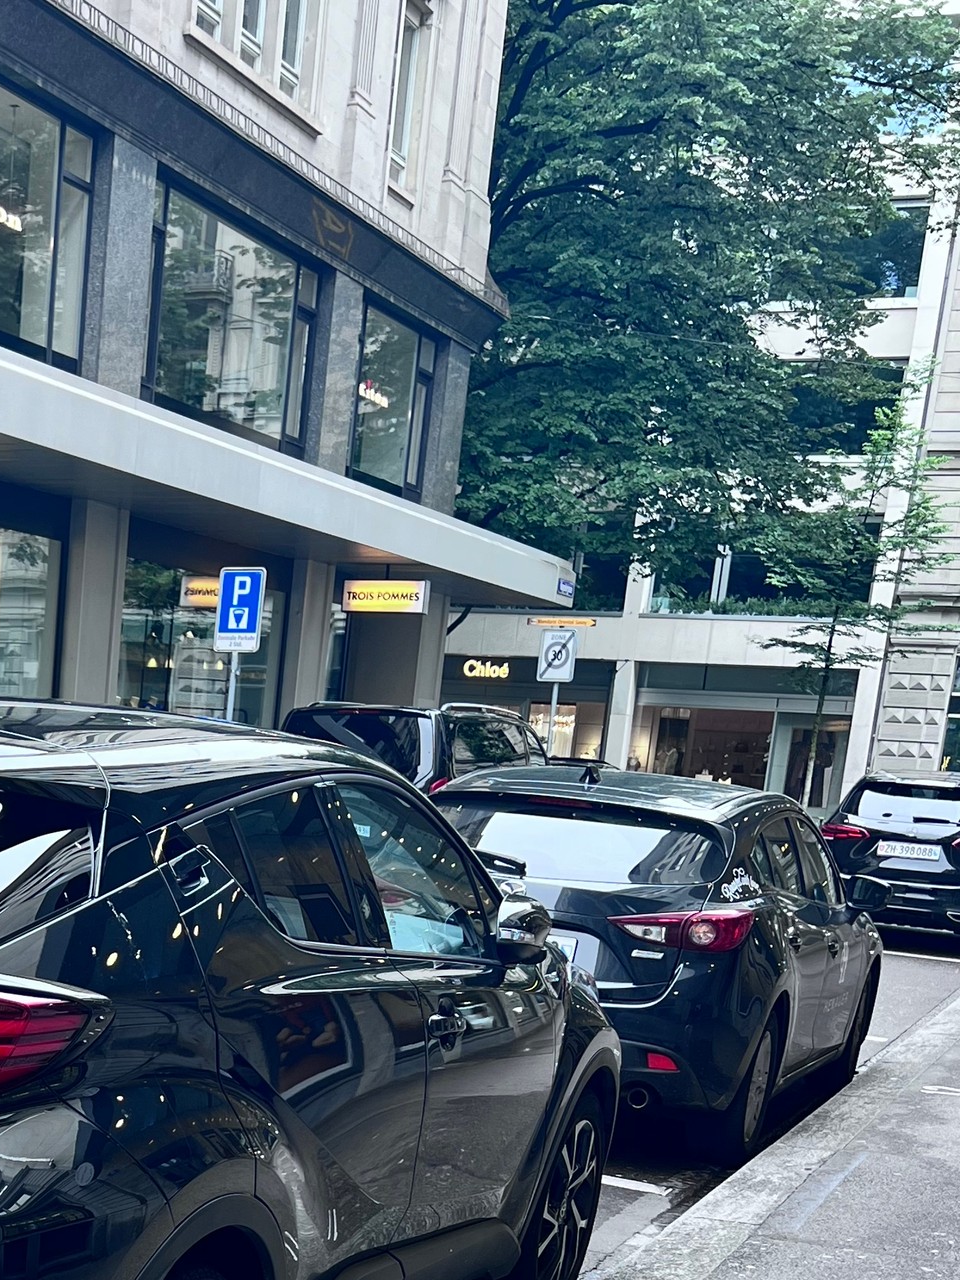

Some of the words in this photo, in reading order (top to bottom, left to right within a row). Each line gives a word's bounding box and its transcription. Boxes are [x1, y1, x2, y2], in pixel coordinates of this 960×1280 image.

[232, 576, 252, 606] P
[347, 591, 374, 601] TROIS
[377, 592, 420, 601] POMMES
[551, 650, 562, 661] 30
[463, 659, 509, 678] Chloé
